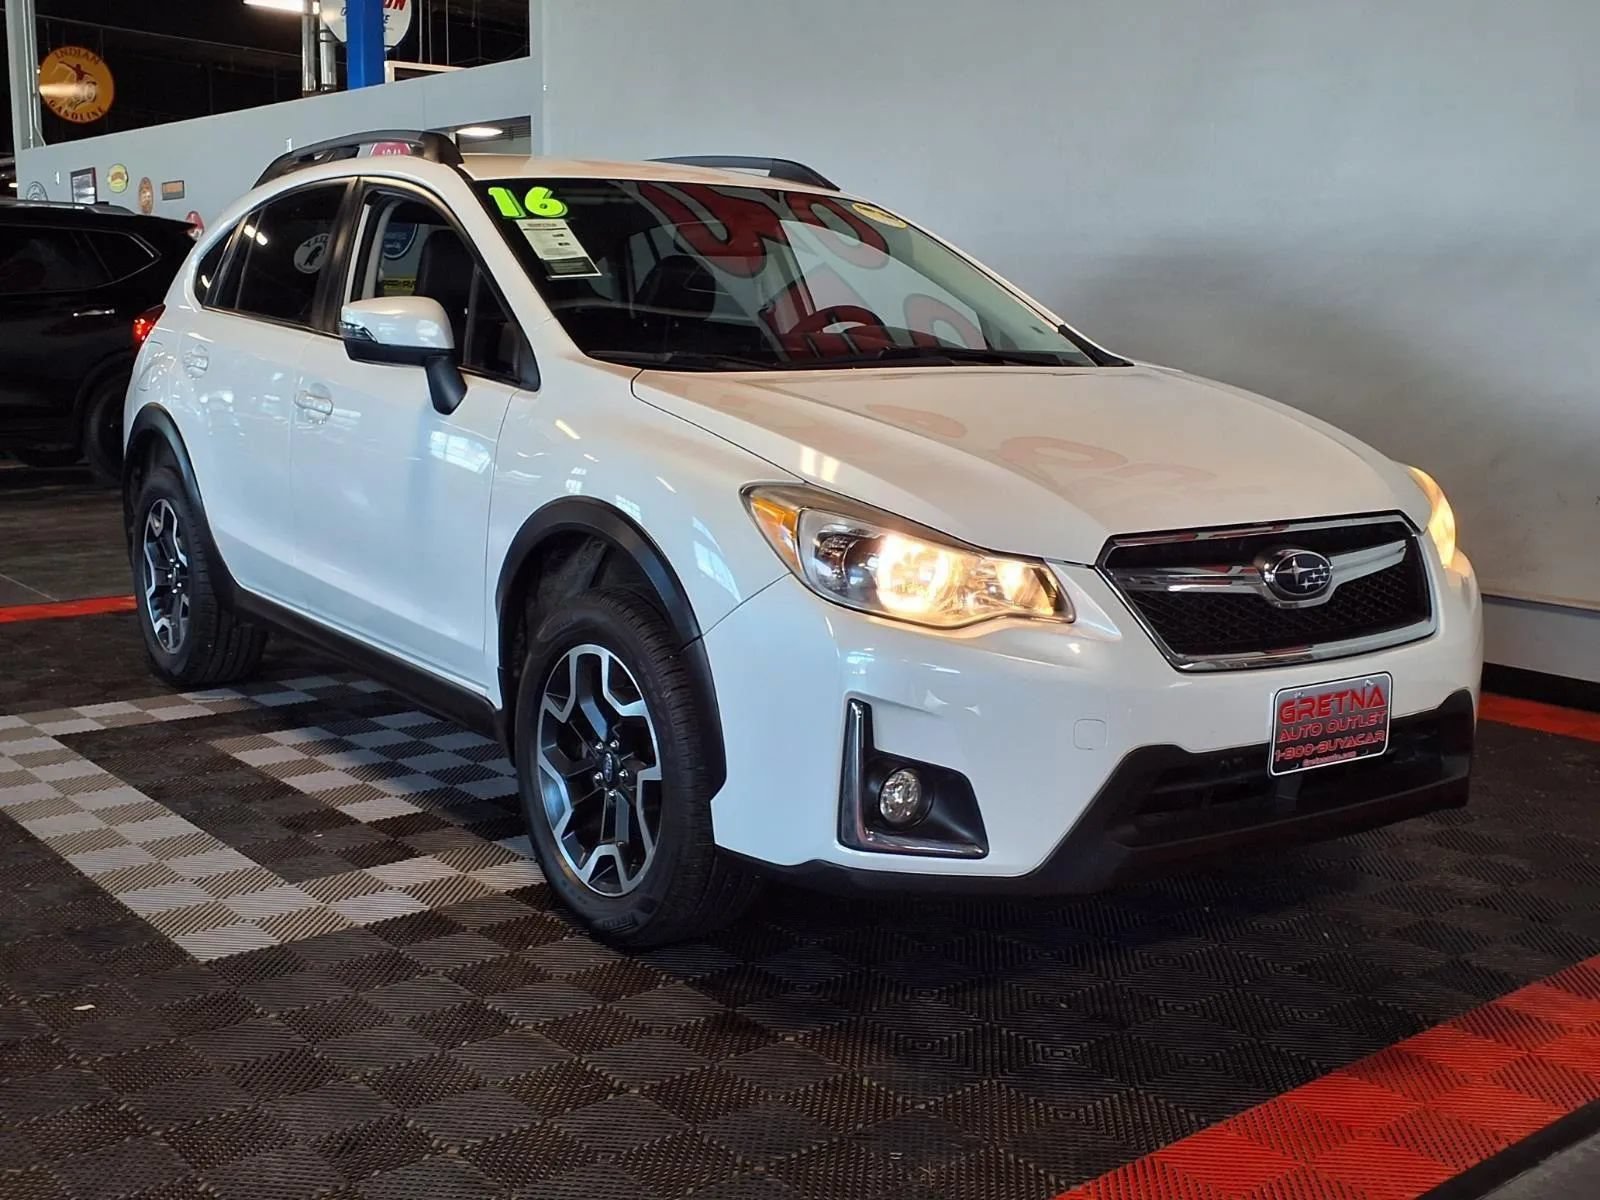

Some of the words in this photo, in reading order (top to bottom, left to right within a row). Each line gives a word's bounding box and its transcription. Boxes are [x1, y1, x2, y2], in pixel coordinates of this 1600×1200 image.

[55, 47, 99, 65] INDIAN
[49, 99, 104, 121] GASOLINE
[488, 186, 568, 218] 16
[1279, 685, 1388, 726] GRETNA
[1279, 722, 1323, 743] AUTO
[1325, 710, 1388, 734] OUTLET
[1275, 729, 1386, 763] 1-800-BUYACAR
